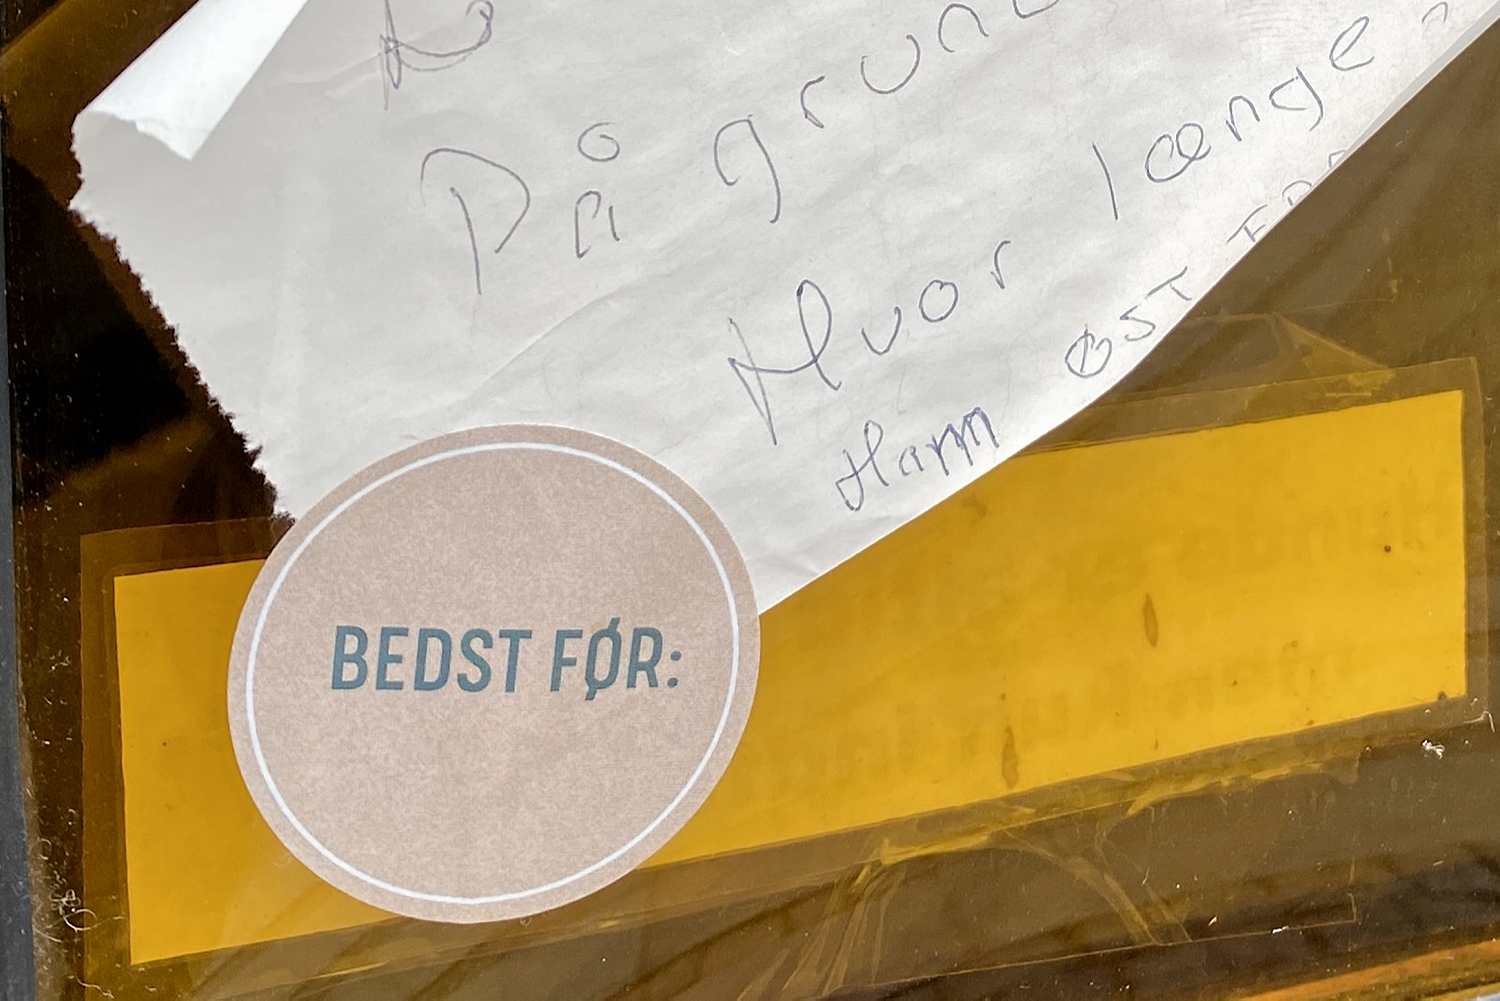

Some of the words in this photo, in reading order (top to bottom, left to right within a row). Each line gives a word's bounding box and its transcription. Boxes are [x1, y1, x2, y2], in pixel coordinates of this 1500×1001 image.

[420, 121, 620, 296] På
[728, 240, 1012, 445] Hvor
[331, 624, 532, 693] BEDST
[549, 617, 683, 701] FØR:
